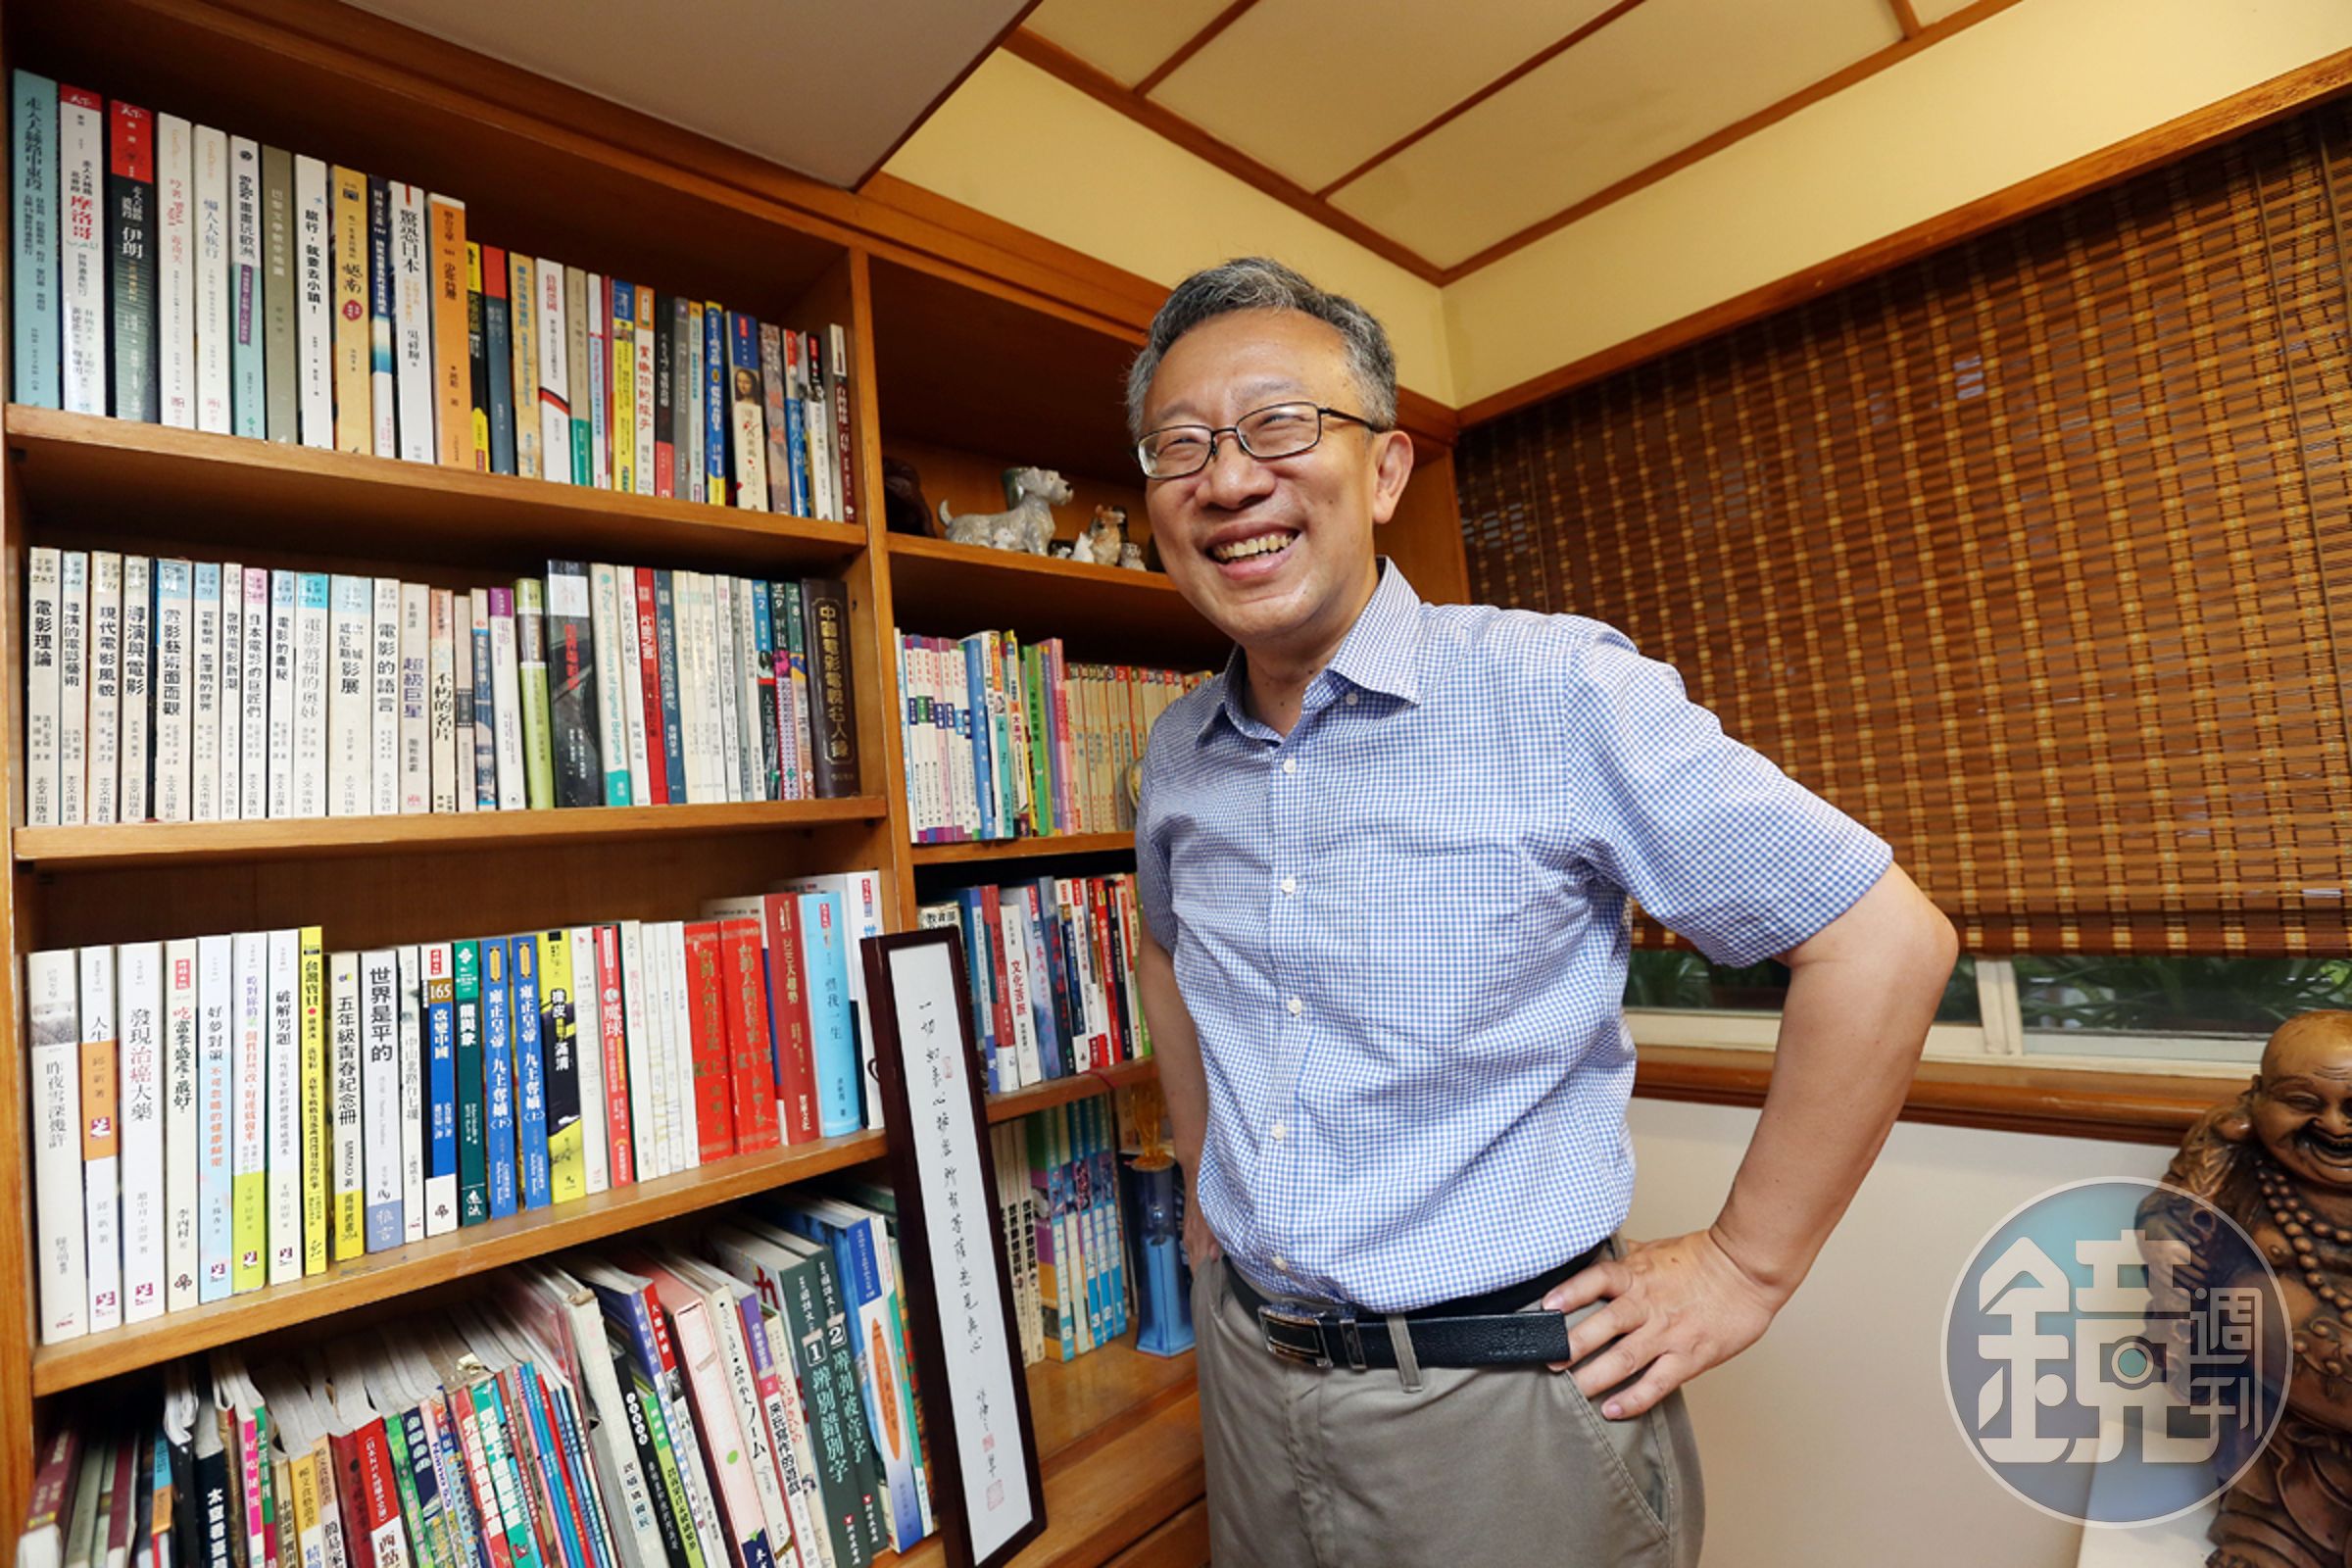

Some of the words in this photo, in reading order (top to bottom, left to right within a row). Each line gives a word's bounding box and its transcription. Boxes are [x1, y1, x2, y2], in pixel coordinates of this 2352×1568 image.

[122, 226, 143, 260] 伊朗
[34, 600, 52, 667] 電影理論
[65, 603, 79, 686] 導演的電影藝術
[98, 607, 116, 697] 現代電影風貌
[125, 606, 145, 695] 導演與電影
[377, 623, 396, 712] 電影的語言
[341, 662, 360, 694] 影展
[404, 658, 423, 718] 超級巨星
[369, 966, 393, 1062] 世界是平的
[430, 984, 452, 999] 165
[89, 1016, 108, 1043] 人生
[130, 1008, 153, 1121] 發現治癌大藥
[337, 996, 357, 1125] 五年級青春紀念冊
[46, 1061, 67, 1149] 昨夜雪深幾許
[809, 1344, 822, 1361] 1
[828, 1326, 845, 1346] 2
